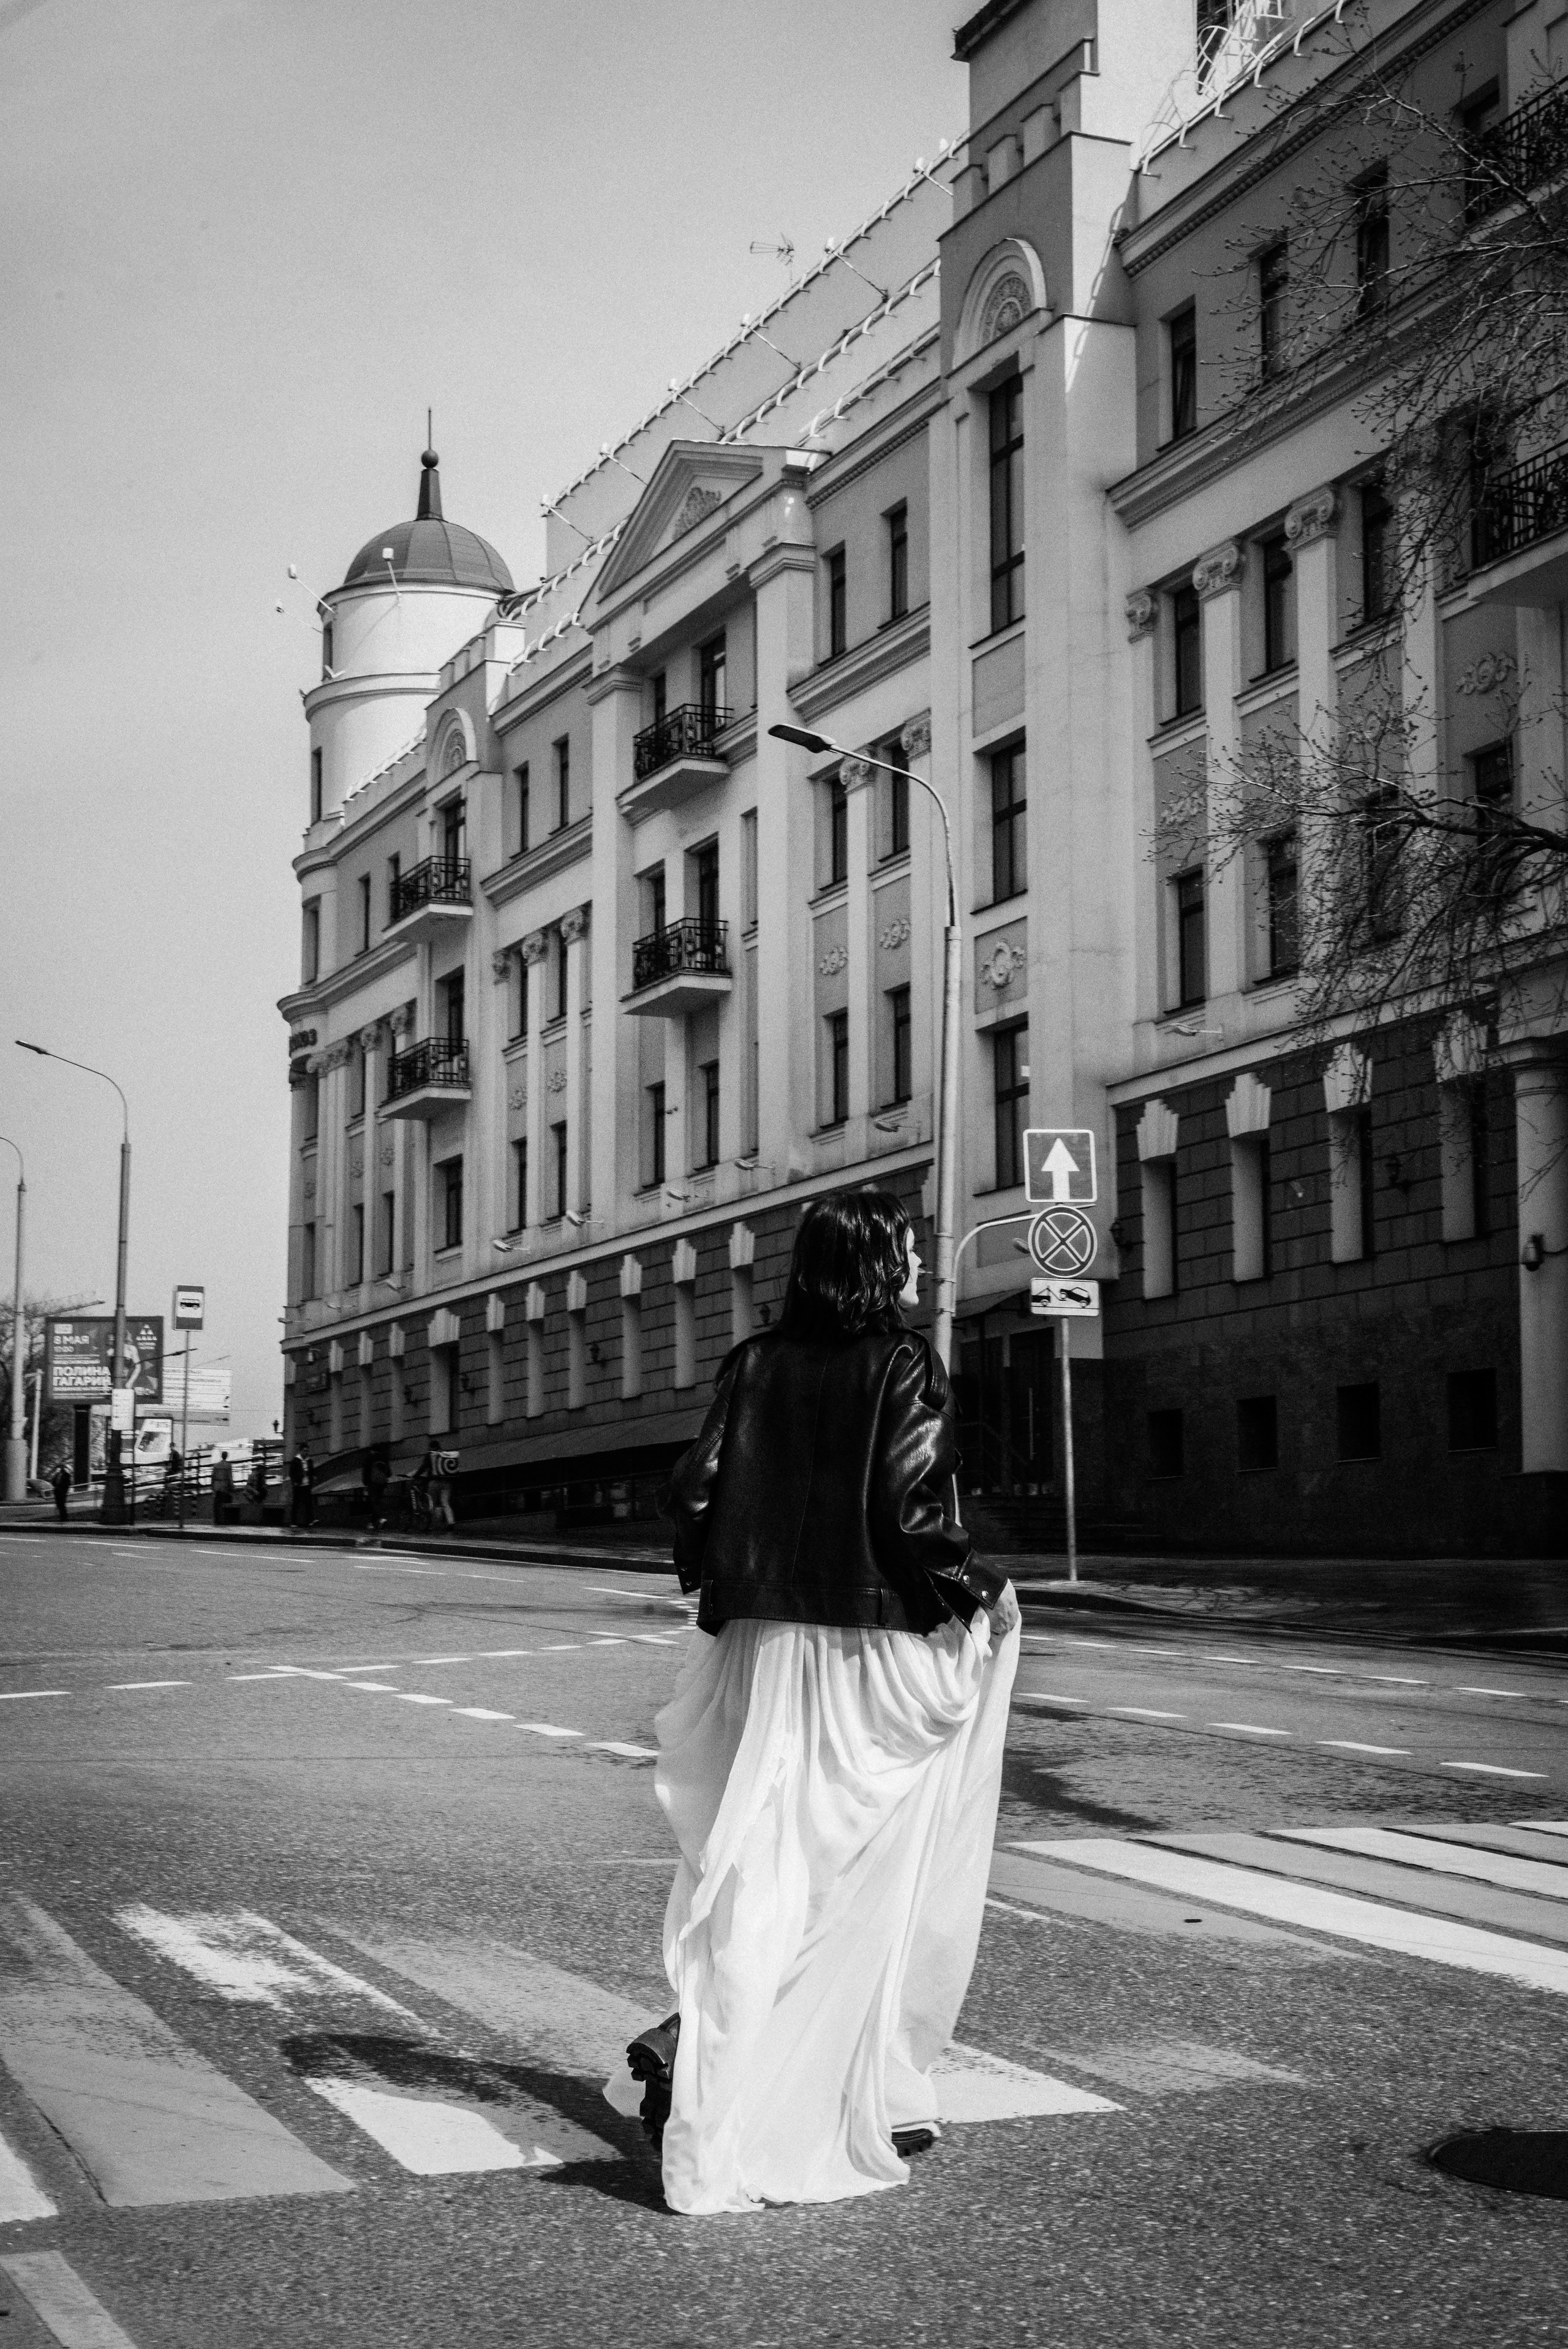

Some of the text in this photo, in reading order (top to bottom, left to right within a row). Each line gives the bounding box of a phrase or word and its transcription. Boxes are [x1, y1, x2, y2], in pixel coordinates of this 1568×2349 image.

[62, 1335, 89, 1344] МАЯ
[53, 1366, 111, 1376] ПОЛИНА
[53, 1376, 113, 1386] ГАГАРИН
